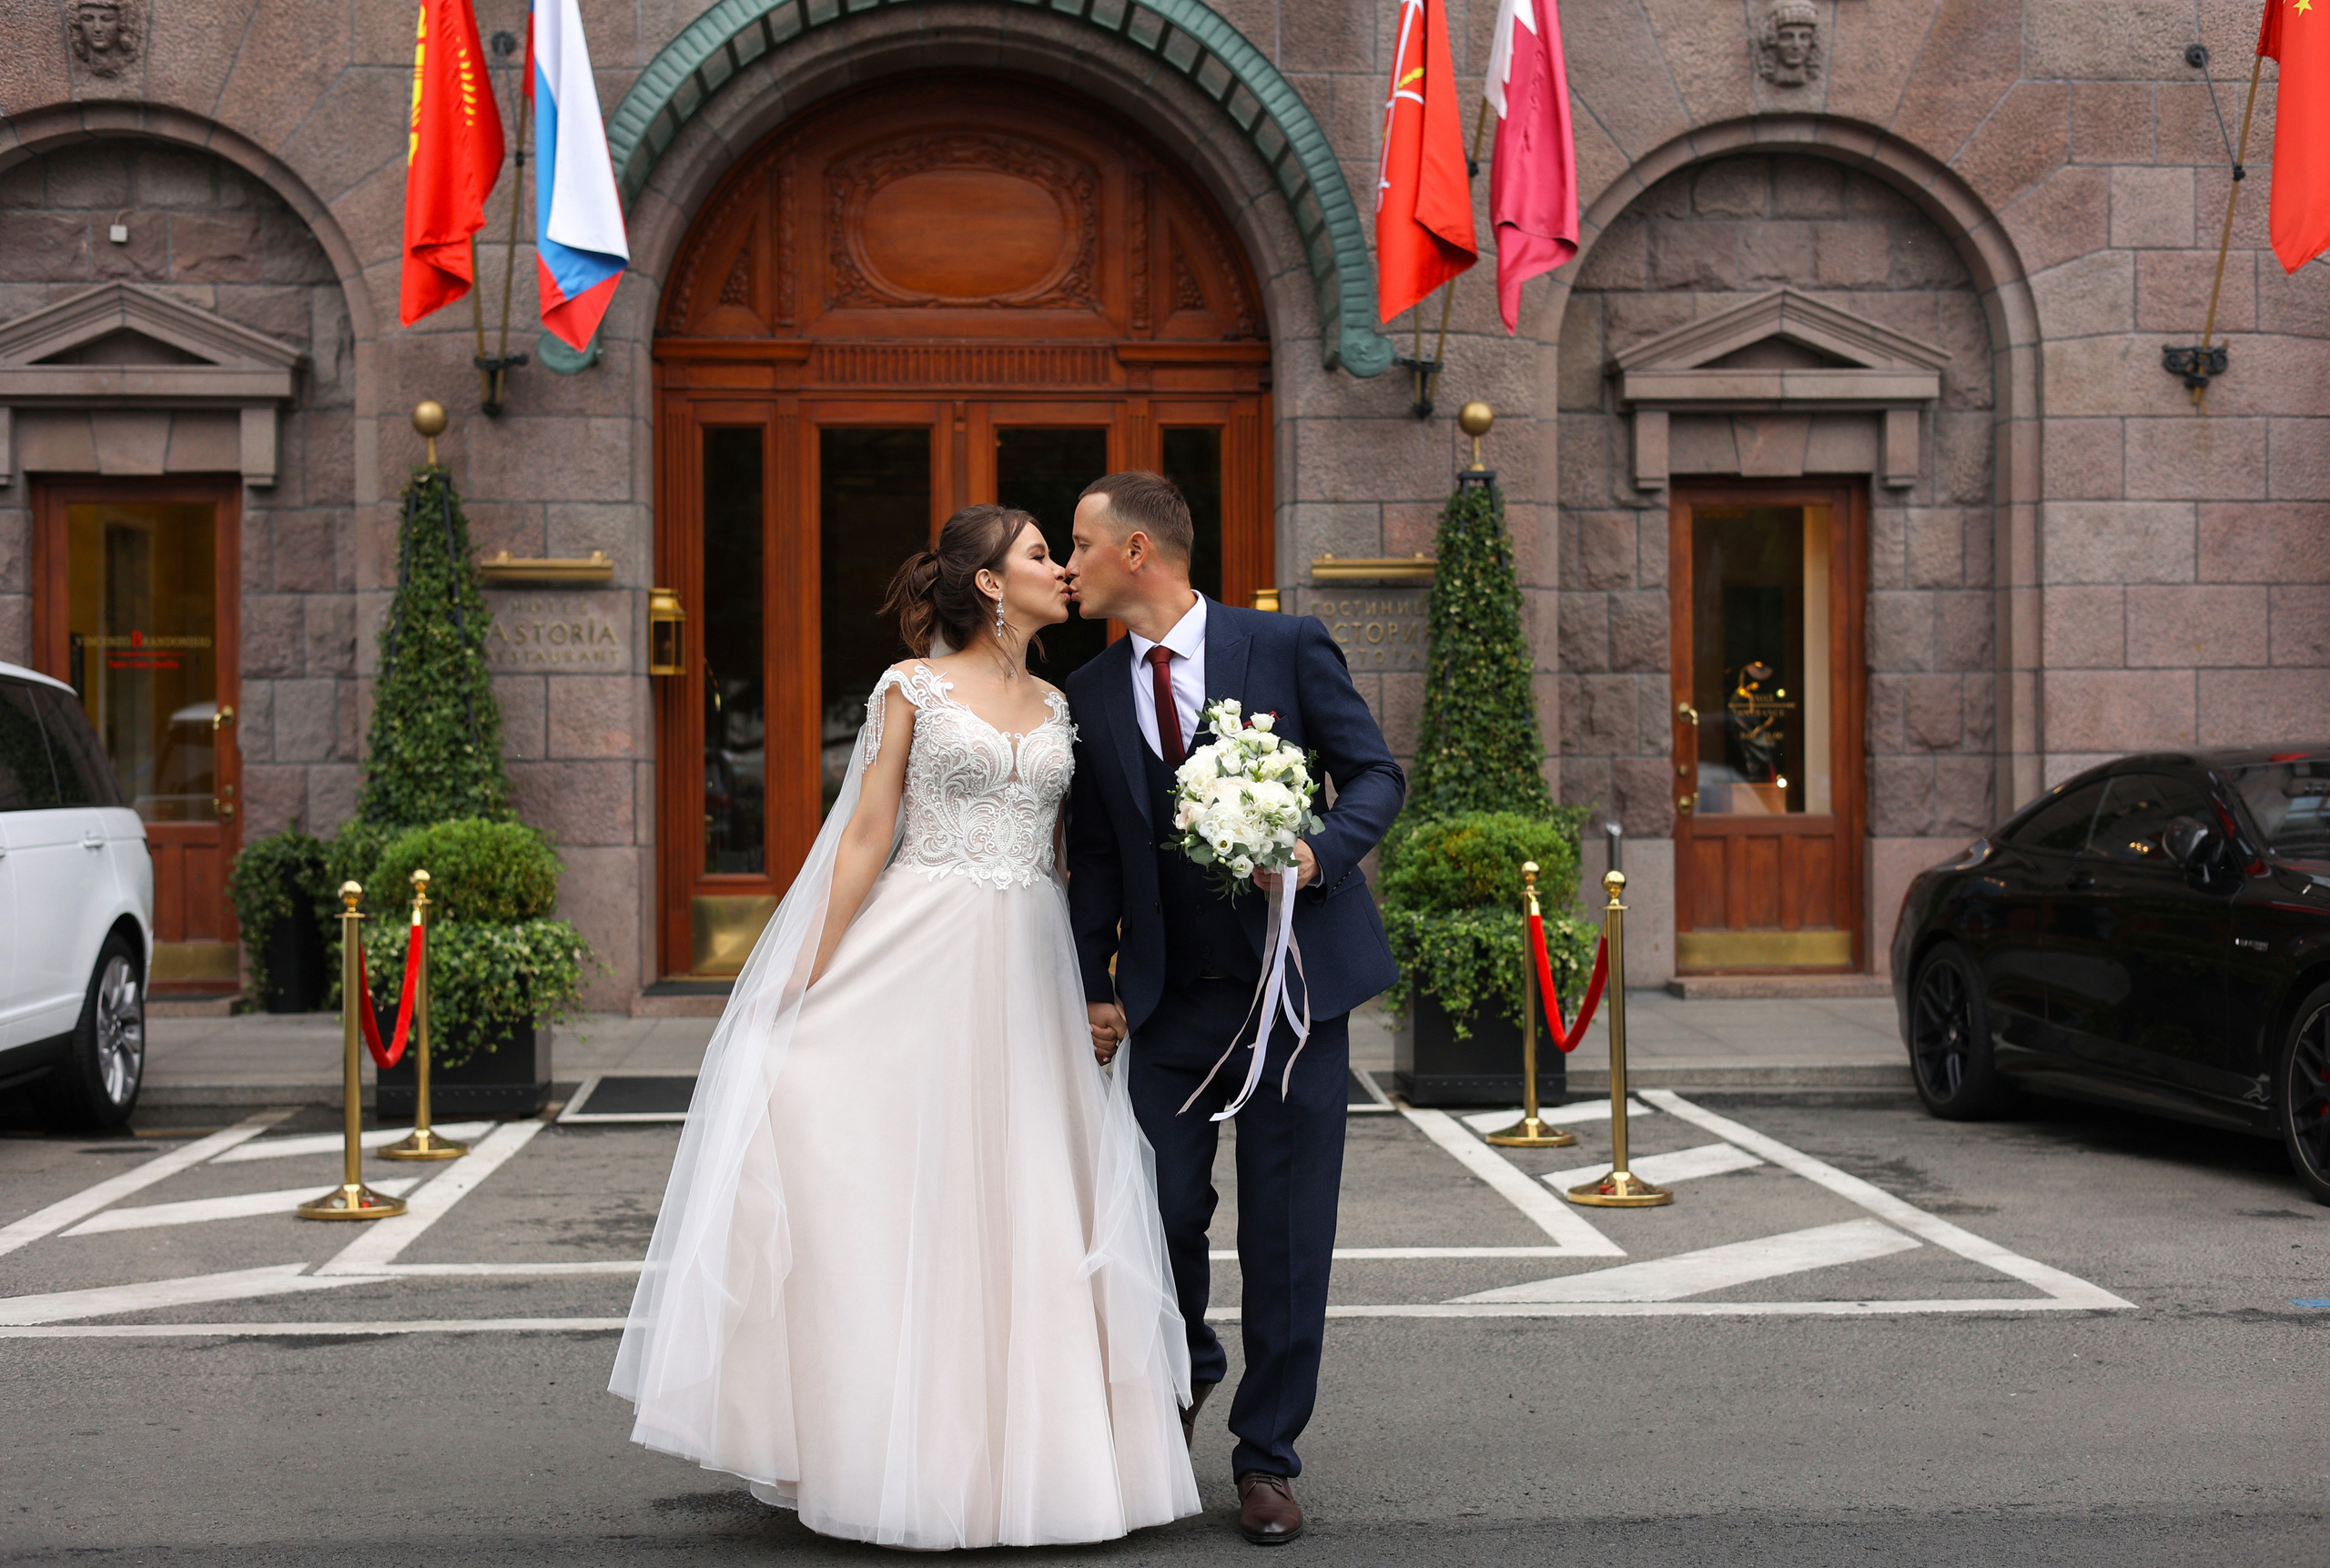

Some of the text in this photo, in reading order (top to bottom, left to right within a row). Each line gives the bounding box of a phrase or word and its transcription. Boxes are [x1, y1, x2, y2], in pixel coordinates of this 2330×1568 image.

[511, 597, 588, 616] HOTEL
[1312, 601, 1426, 616] ГОСТИНИЦ
[488, 619, 617, 645] ASTORIA
[1332, 621, 1432, 644] СТОРИ
